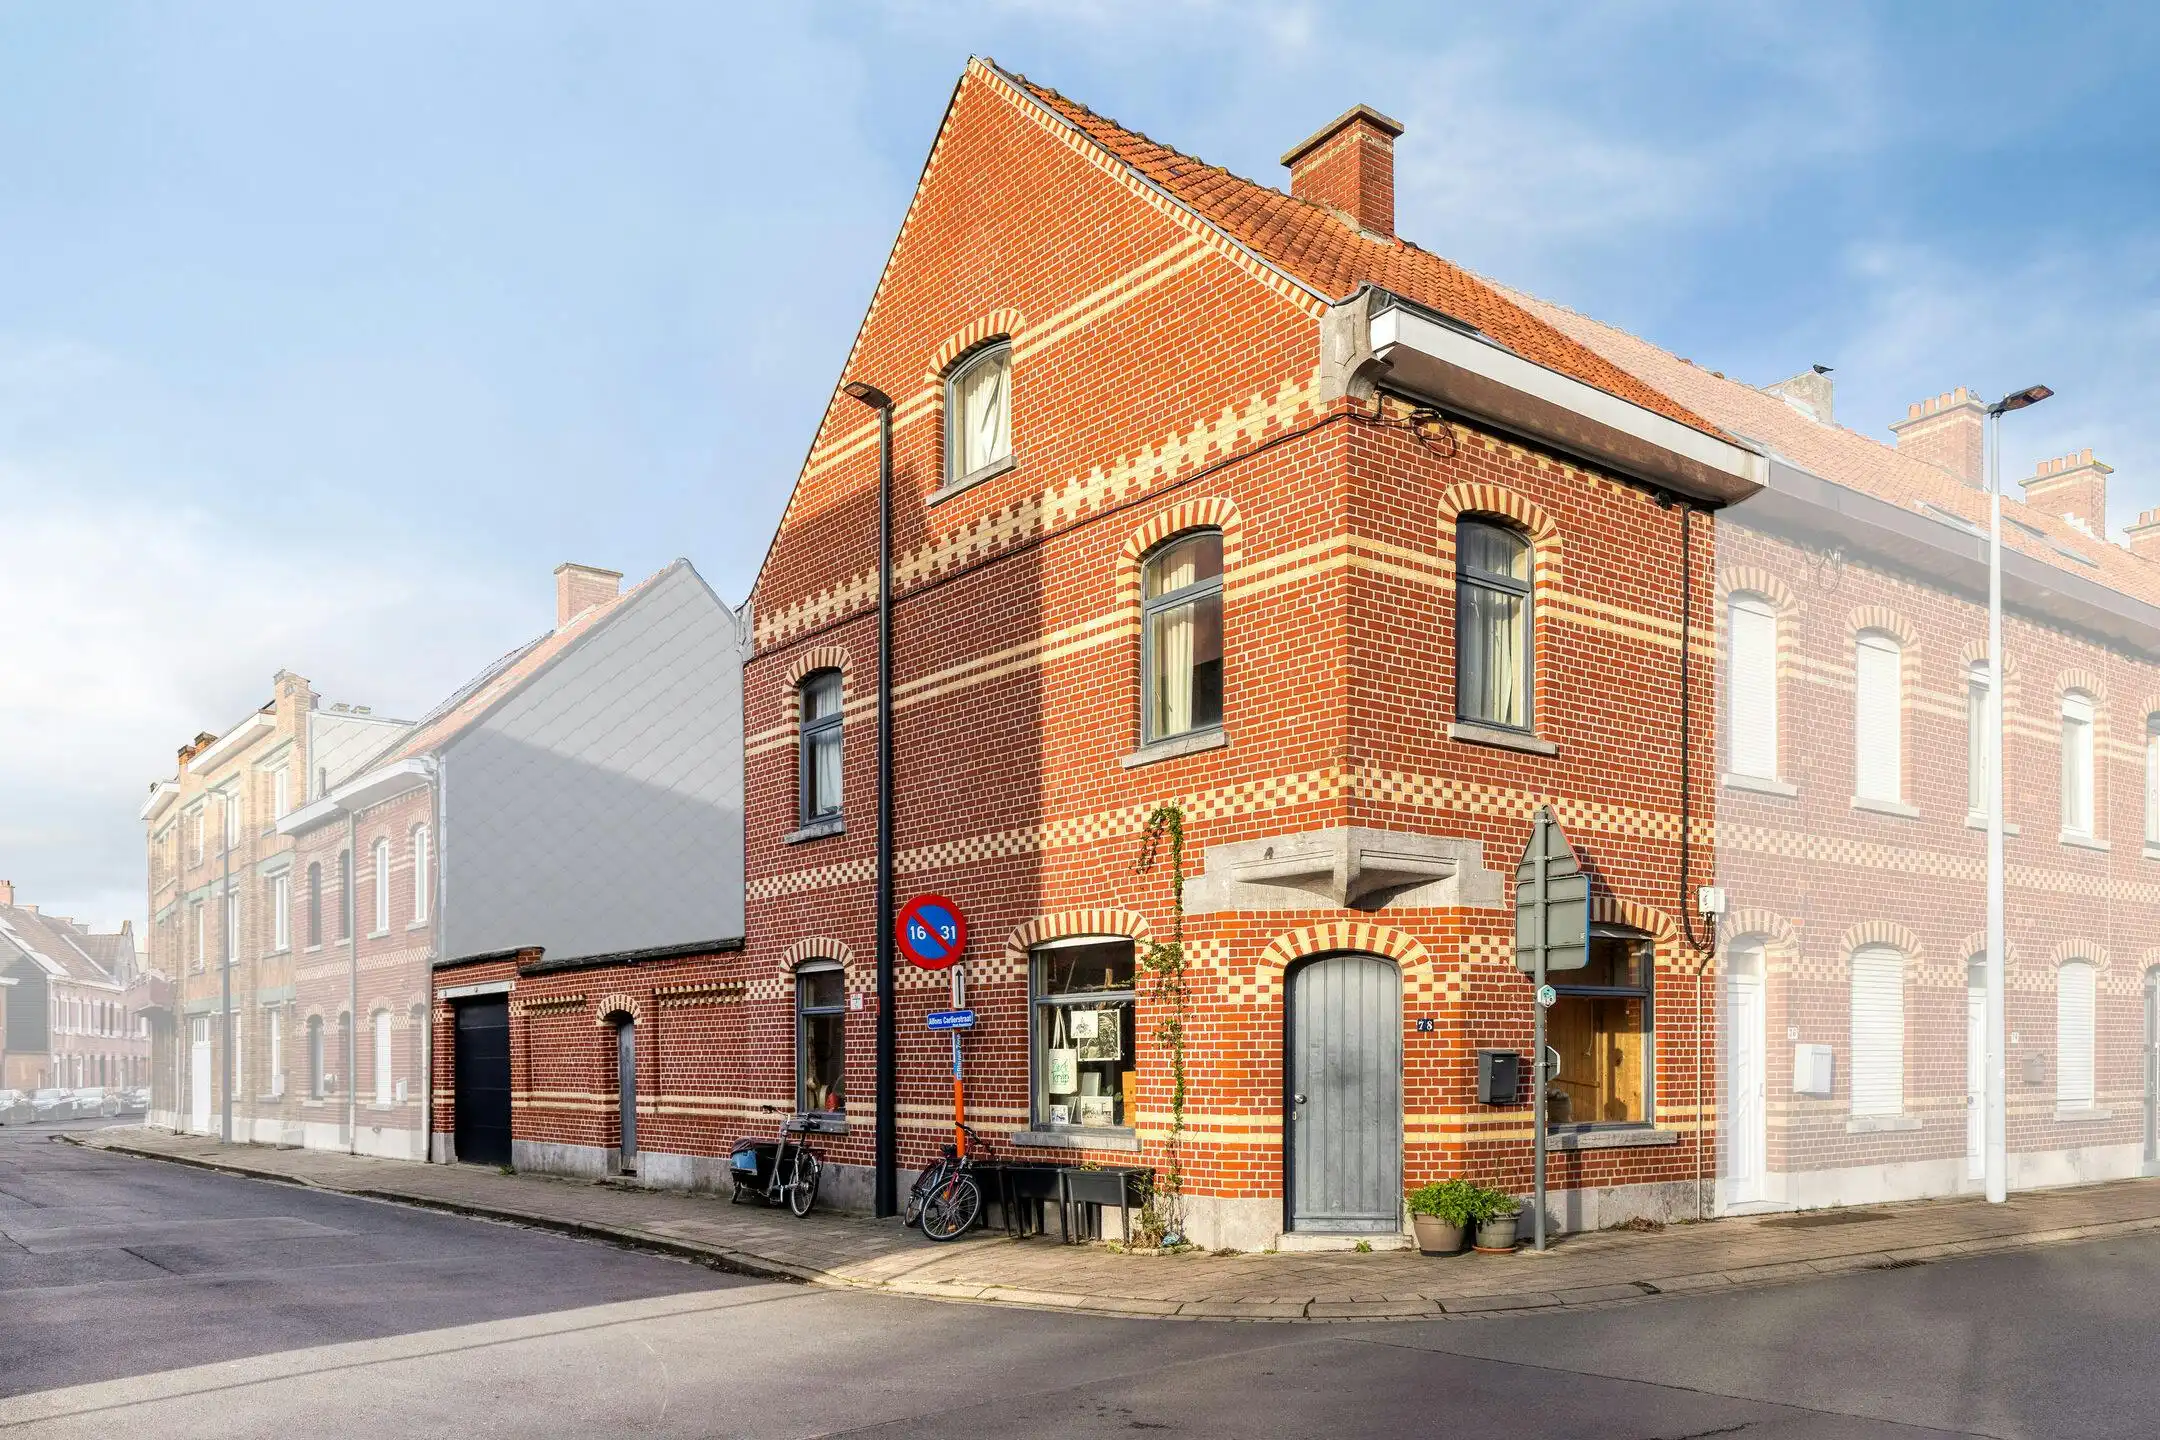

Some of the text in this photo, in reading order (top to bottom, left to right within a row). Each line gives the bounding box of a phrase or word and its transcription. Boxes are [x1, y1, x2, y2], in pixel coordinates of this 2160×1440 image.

[910, 925, 956, 940] 16 31
[1418, 1020, 1433, 1031] 78
